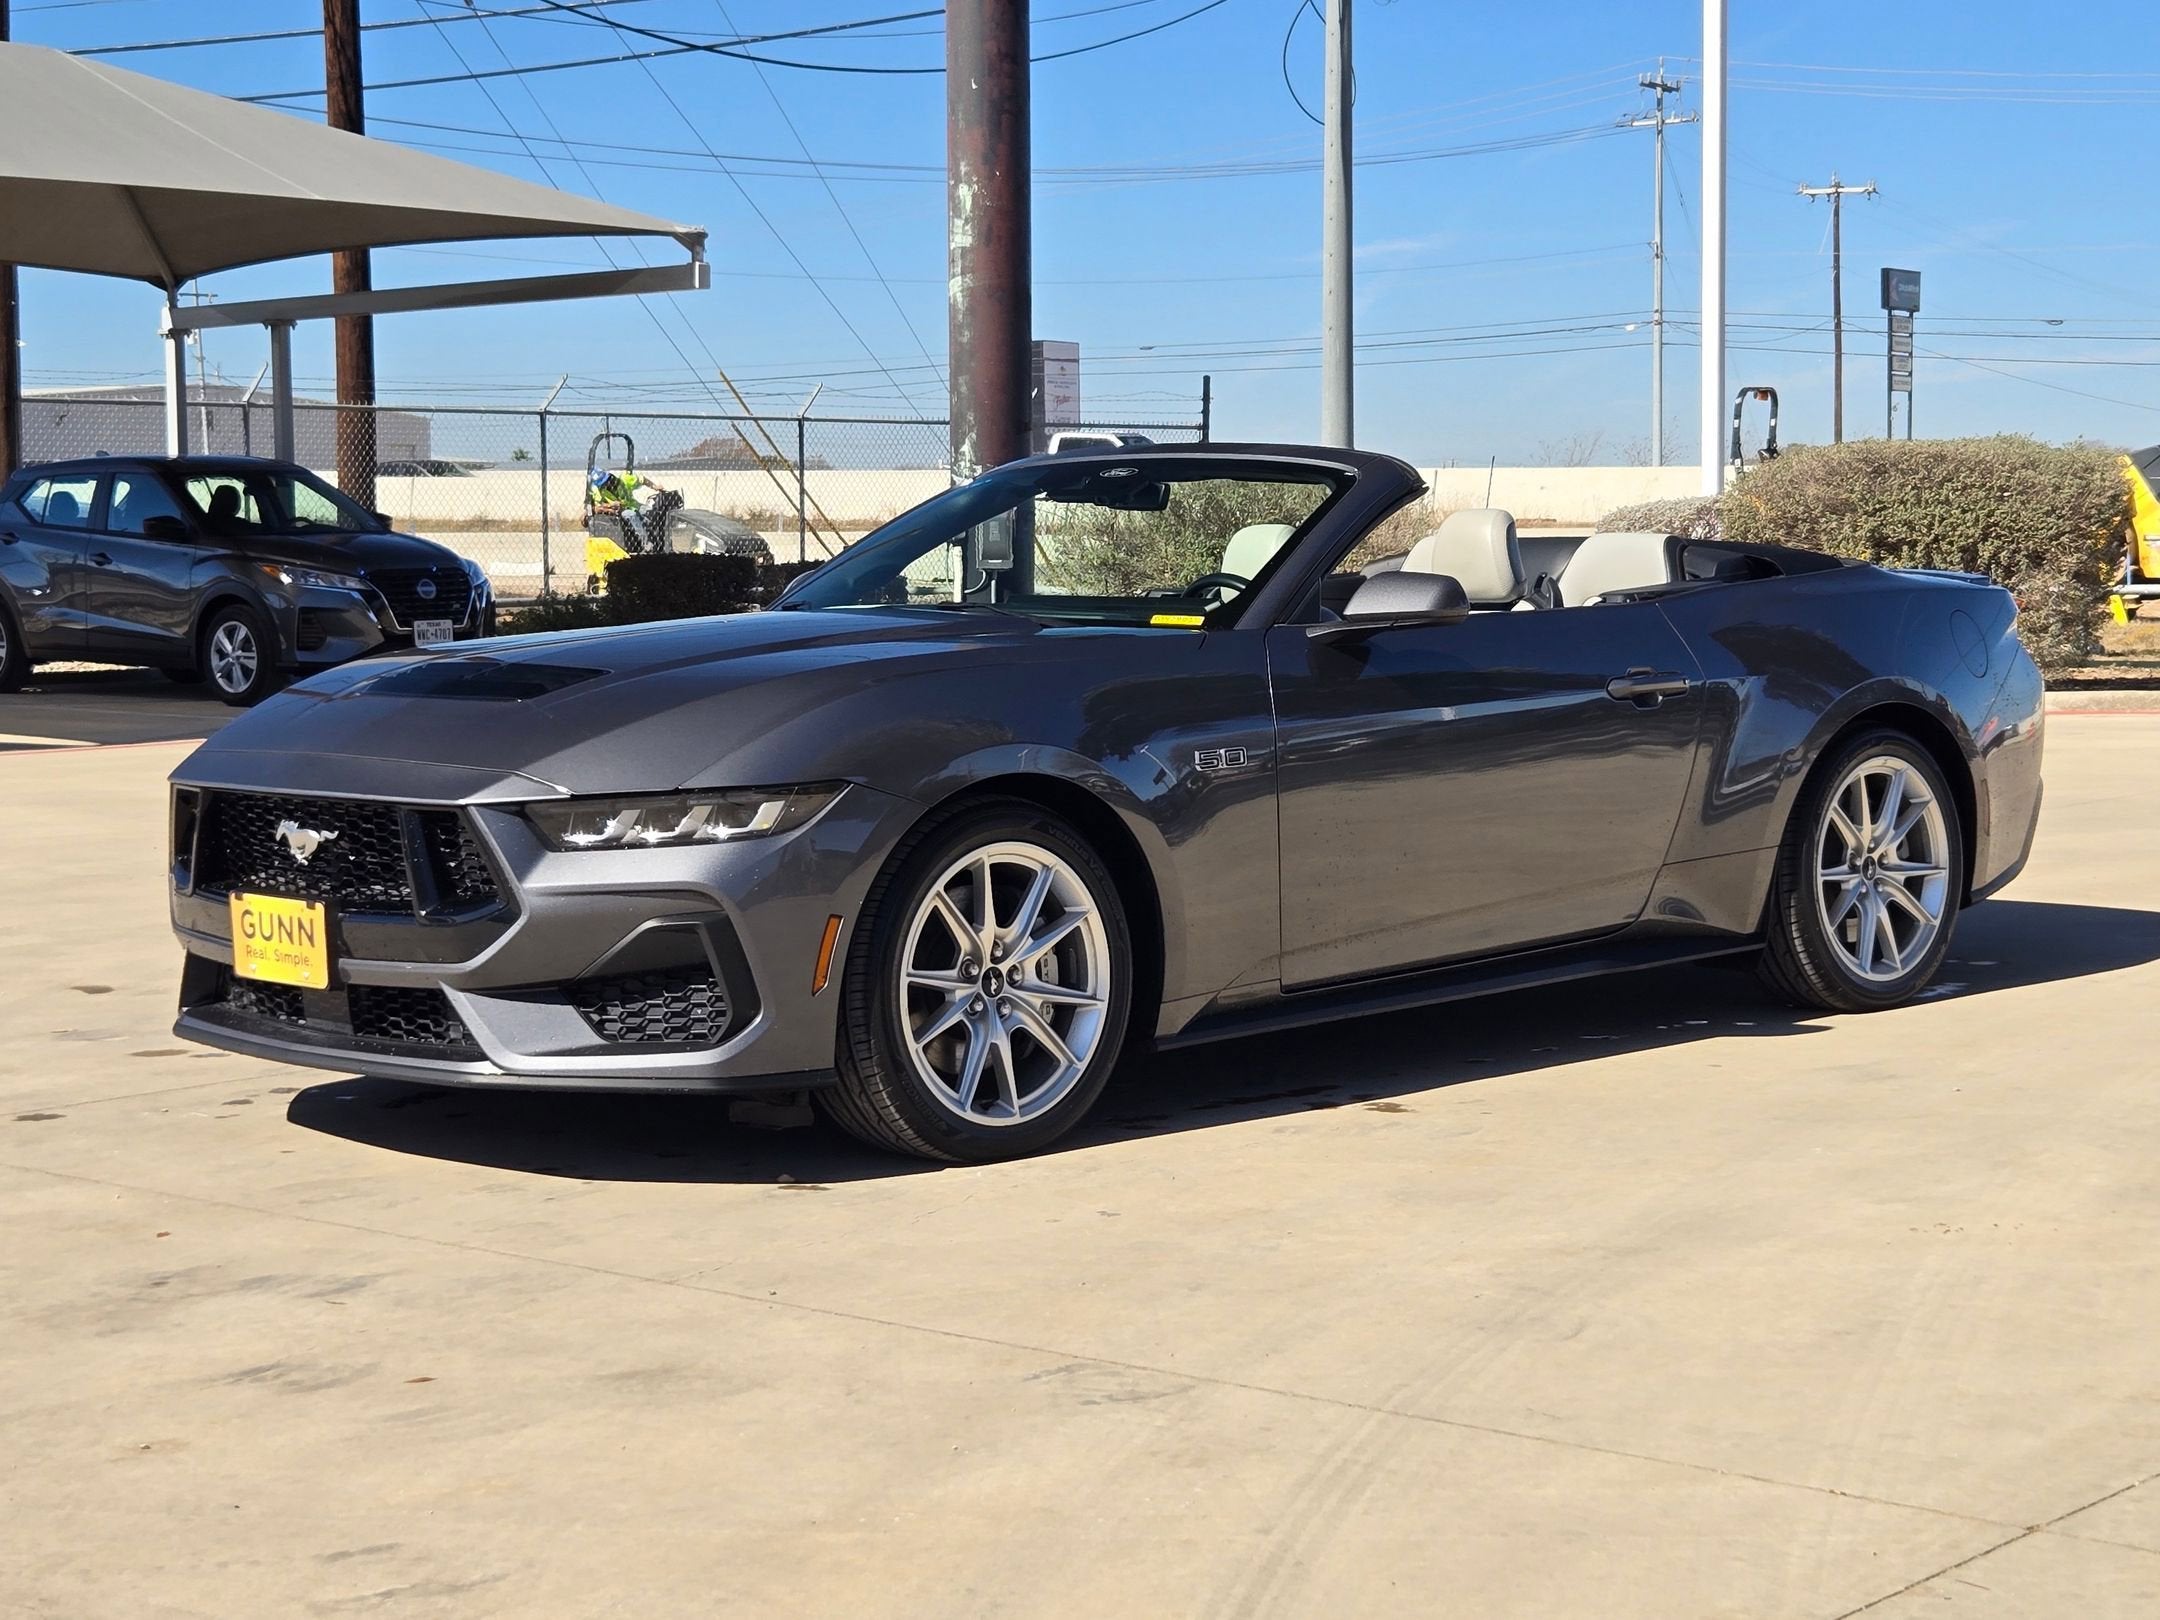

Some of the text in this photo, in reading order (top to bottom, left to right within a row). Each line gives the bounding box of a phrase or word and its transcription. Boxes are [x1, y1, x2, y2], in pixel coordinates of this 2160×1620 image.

[241, 909, 315, 948] GUNN
[246, 944, 313, 967] Real. Simple.
